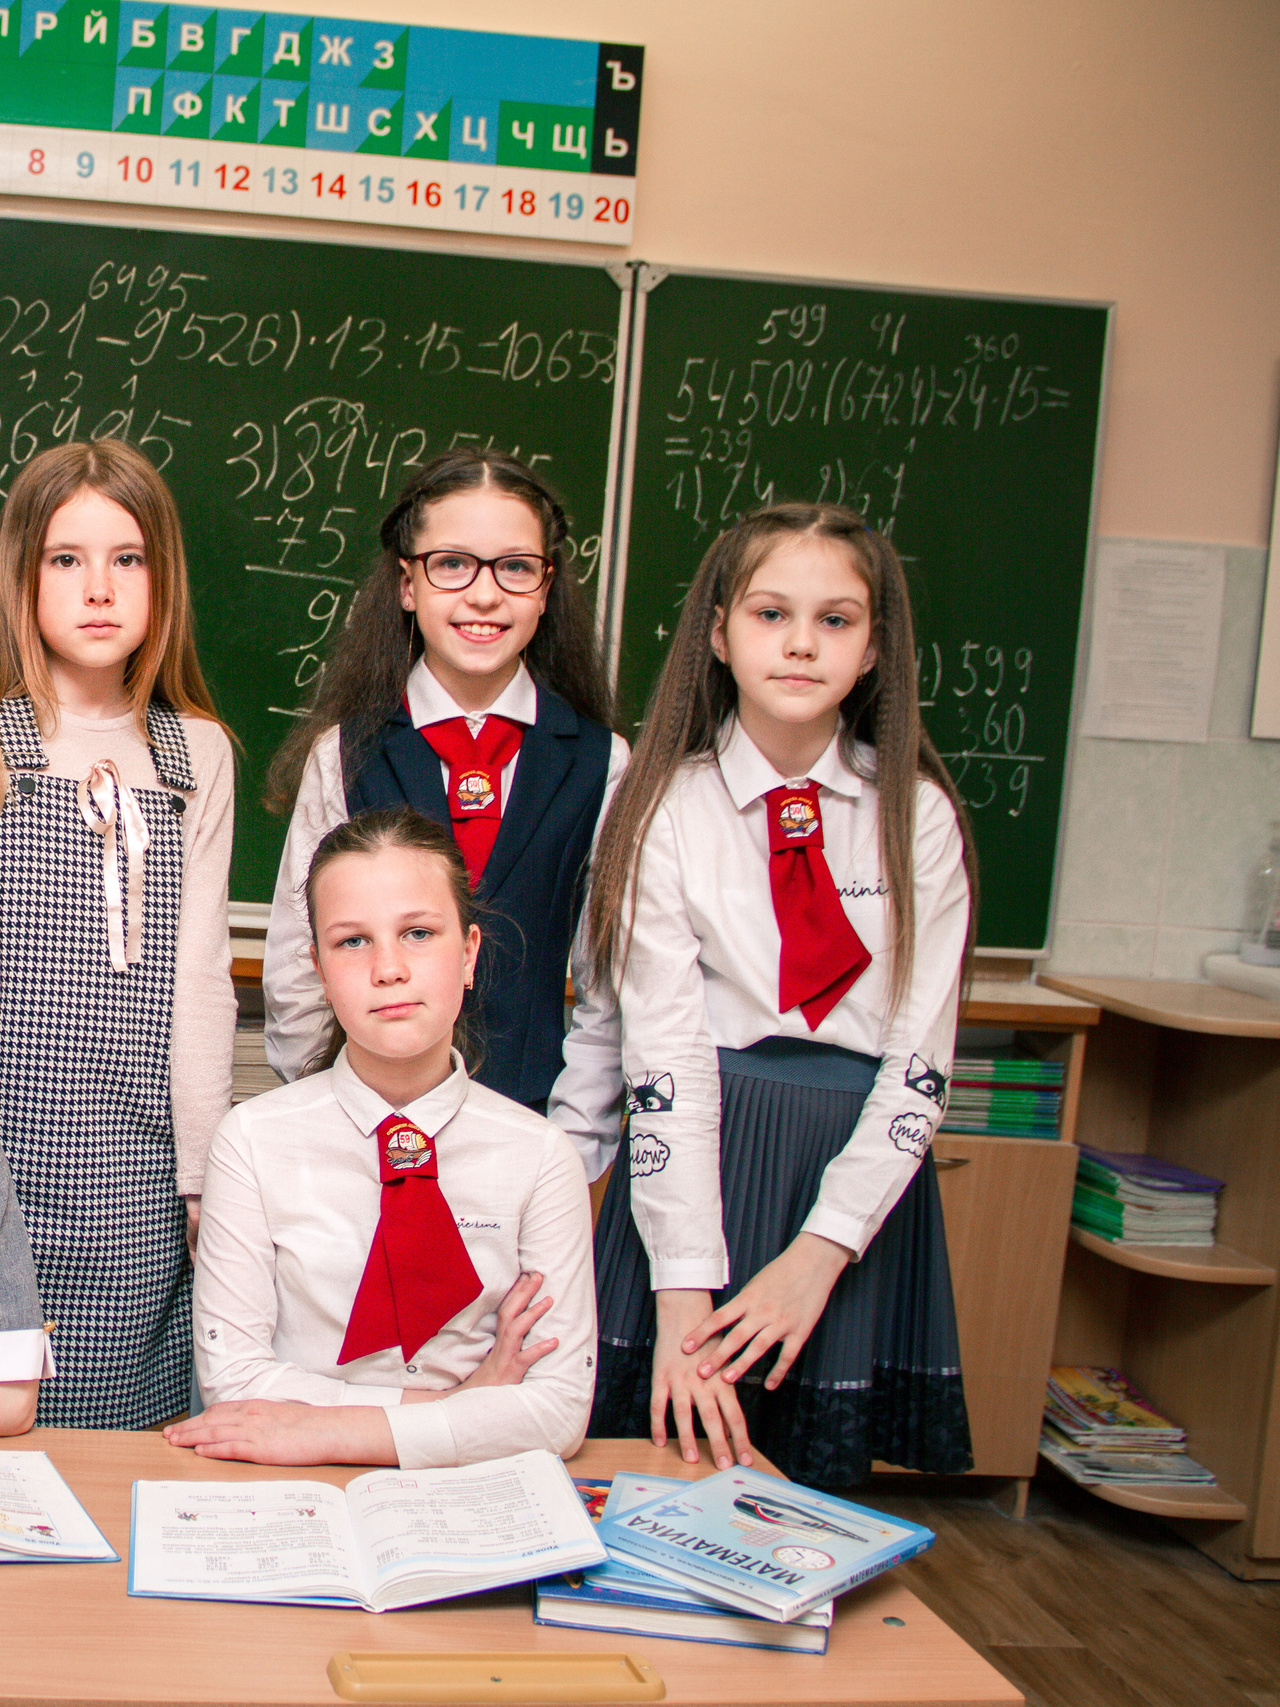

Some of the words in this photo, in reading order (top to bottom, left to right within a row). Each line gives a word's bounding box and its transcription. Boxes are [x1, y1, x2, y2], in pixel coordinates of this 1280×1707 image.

[33, 9, 59, 40] Р
[83, 9, 108, 44] Й
[130, 17, 156, 48] Б
[178, 21, 205, 52] В
[229, 26, 252, 56] Г
[272, 30, 301, 67] Д
[317, 33, 355, 67] Ж
[372, 39, 395, 70] З
[606, 61, 636, 91] Ъ
[126, 84, 153, 116] П
[171, 89, 203, 119] Ф
[224, 93, 248, 124] К
[271, 97, 296, 128] Т
[314, 101, 351, 135] Ш
[366, 106, 393, 137] С
[413, 110, 439, 142] Х
[461, 114, 488, 153] Ц
[512, 120, 535, 150] Ч
[552, 123, 588, 160] Щ
[605, 128, 629, 158] Ь
[28, 148, 46, 175] 8
[76, 151, 95, 179] 9
[117, 155, 154, 184] 10
[168, 158, 202, 188] 11
[214, 163, 251, 192] 12
[262, 166, 300, 196] 13
[310, 171, 348, 201] 14
[358, 175, 396, 204] 15
[405, 179, 443, 209] 16
[453, 184, 490, 213] 17
[500, 187, 537, 217] 18
[547, 192, 585, 221] 19
[592, 195, 631, 225] 20
[651, 1503, 690, 1518] 4
[626, 1514, 806, 1586] МАТЕМАТИКА
[849, 1559, 890, 1586] МАТЕМАТИКА
